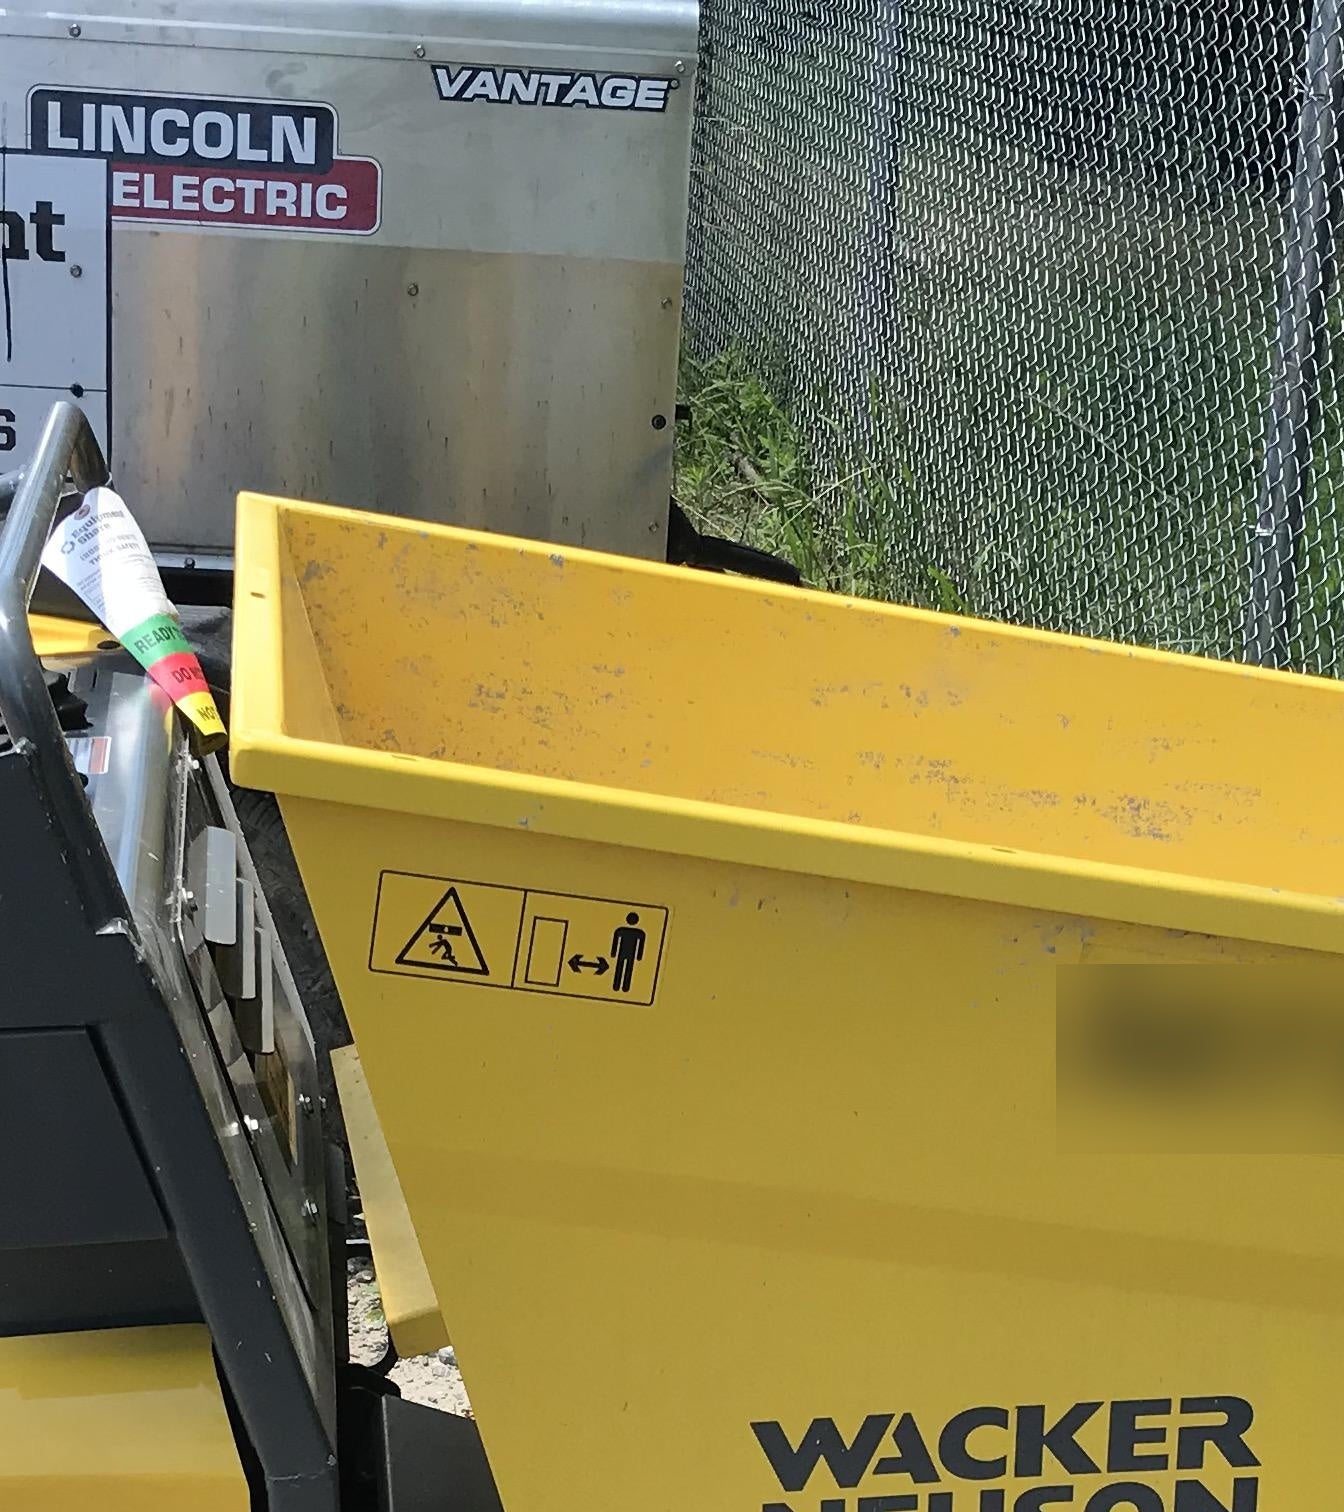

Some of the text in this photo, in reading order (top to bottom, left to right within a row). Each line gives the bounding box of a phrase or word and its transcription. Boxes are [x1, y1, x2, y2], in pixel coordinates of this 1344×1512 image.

[433, 66, 671, 110] VANTAGE
[47, 101, 317, 165] LINCOLN
[112, 172, 348, 221] ELECTRIC
[134, 625, 176, 654] READY
[172, 667, 192, 684] DO
[749, 1395, 1262, 1492] WACKER
